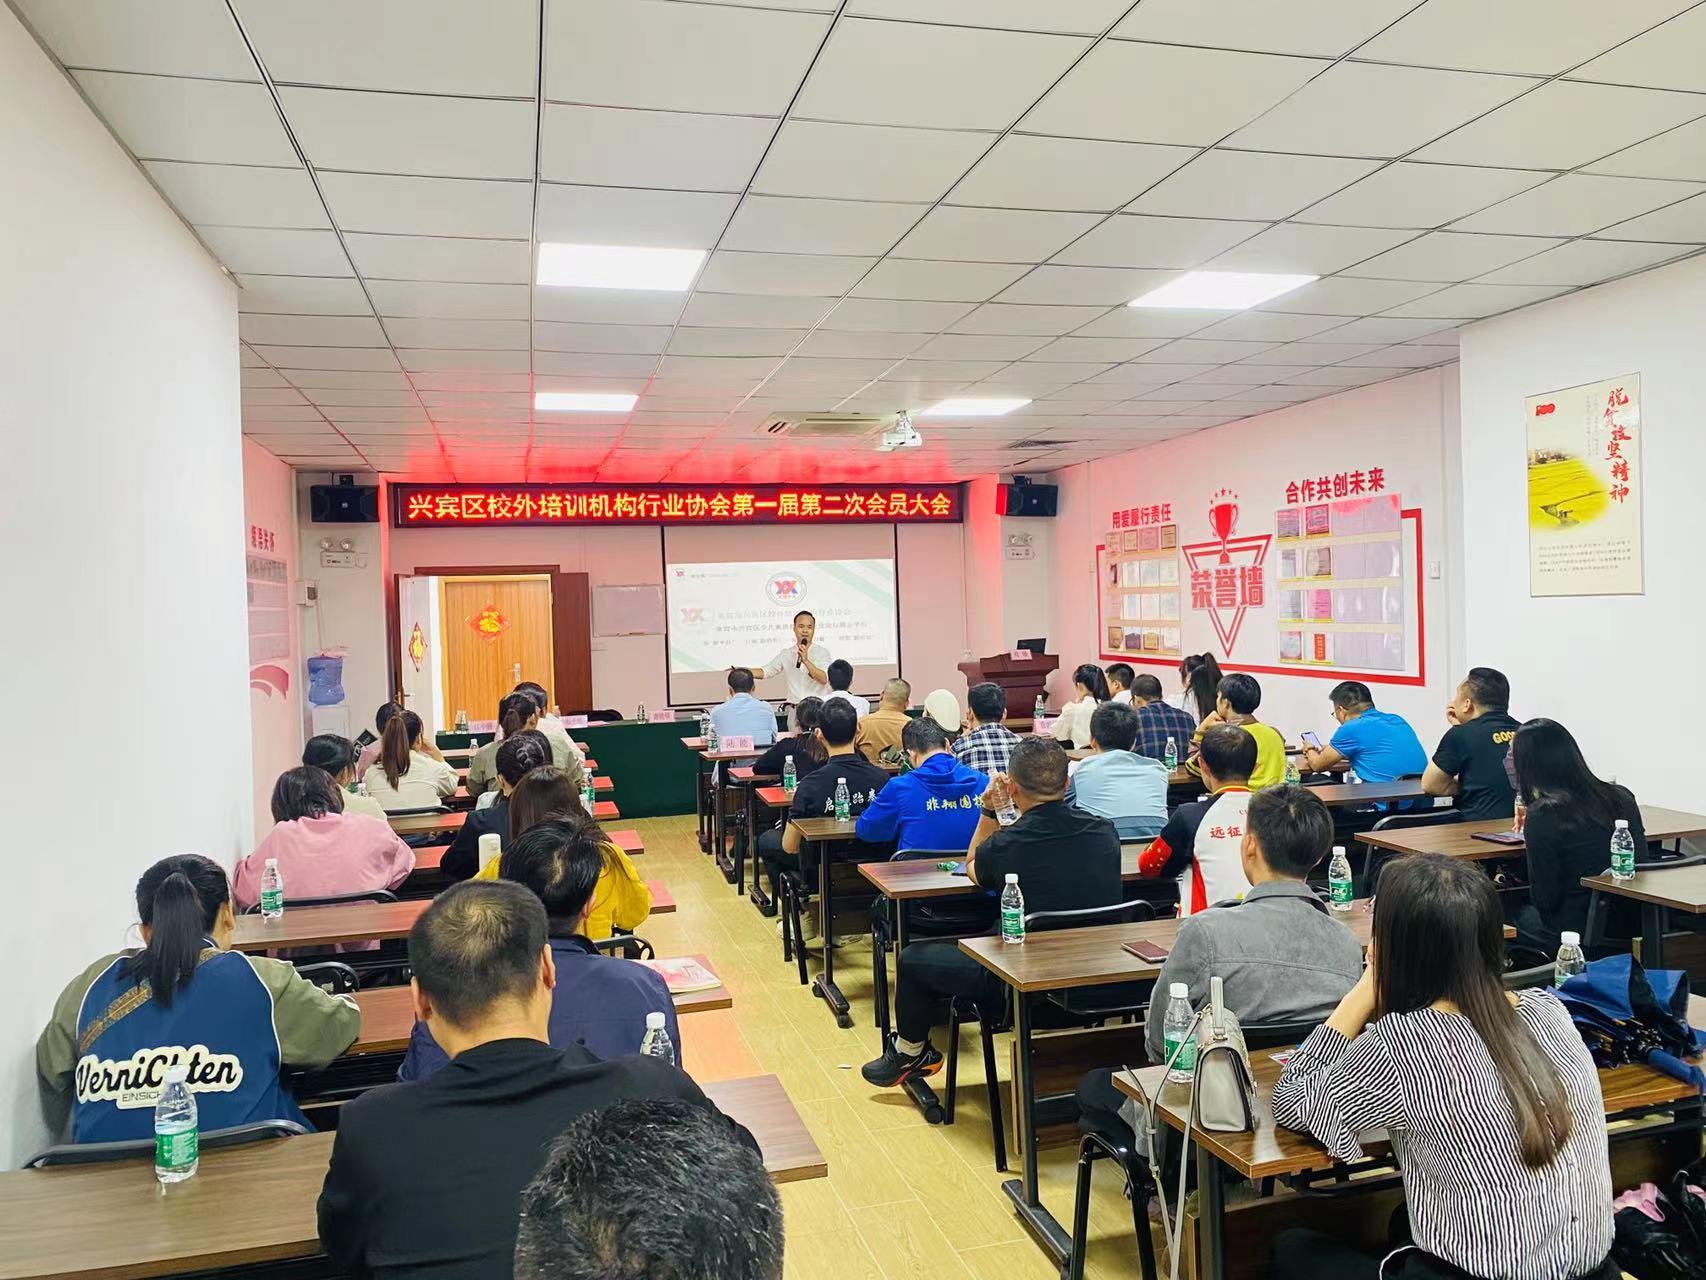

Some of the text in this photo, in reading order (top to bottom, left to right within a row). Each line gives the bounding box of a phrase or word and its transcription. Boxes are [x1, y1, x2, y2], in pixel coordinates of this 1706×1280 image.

[1286, 467, 1385, 504] 合作共创未来
[408, 492, 952, 520] 兴宾区校外培训机构行业协会第一届第二次会员大会
[1112, 503, 1171, 529] 用爱履行责任
[1191, 565, 1264, 609] 荣誉墙
[824, 787, 878, 813] 启跆拳
